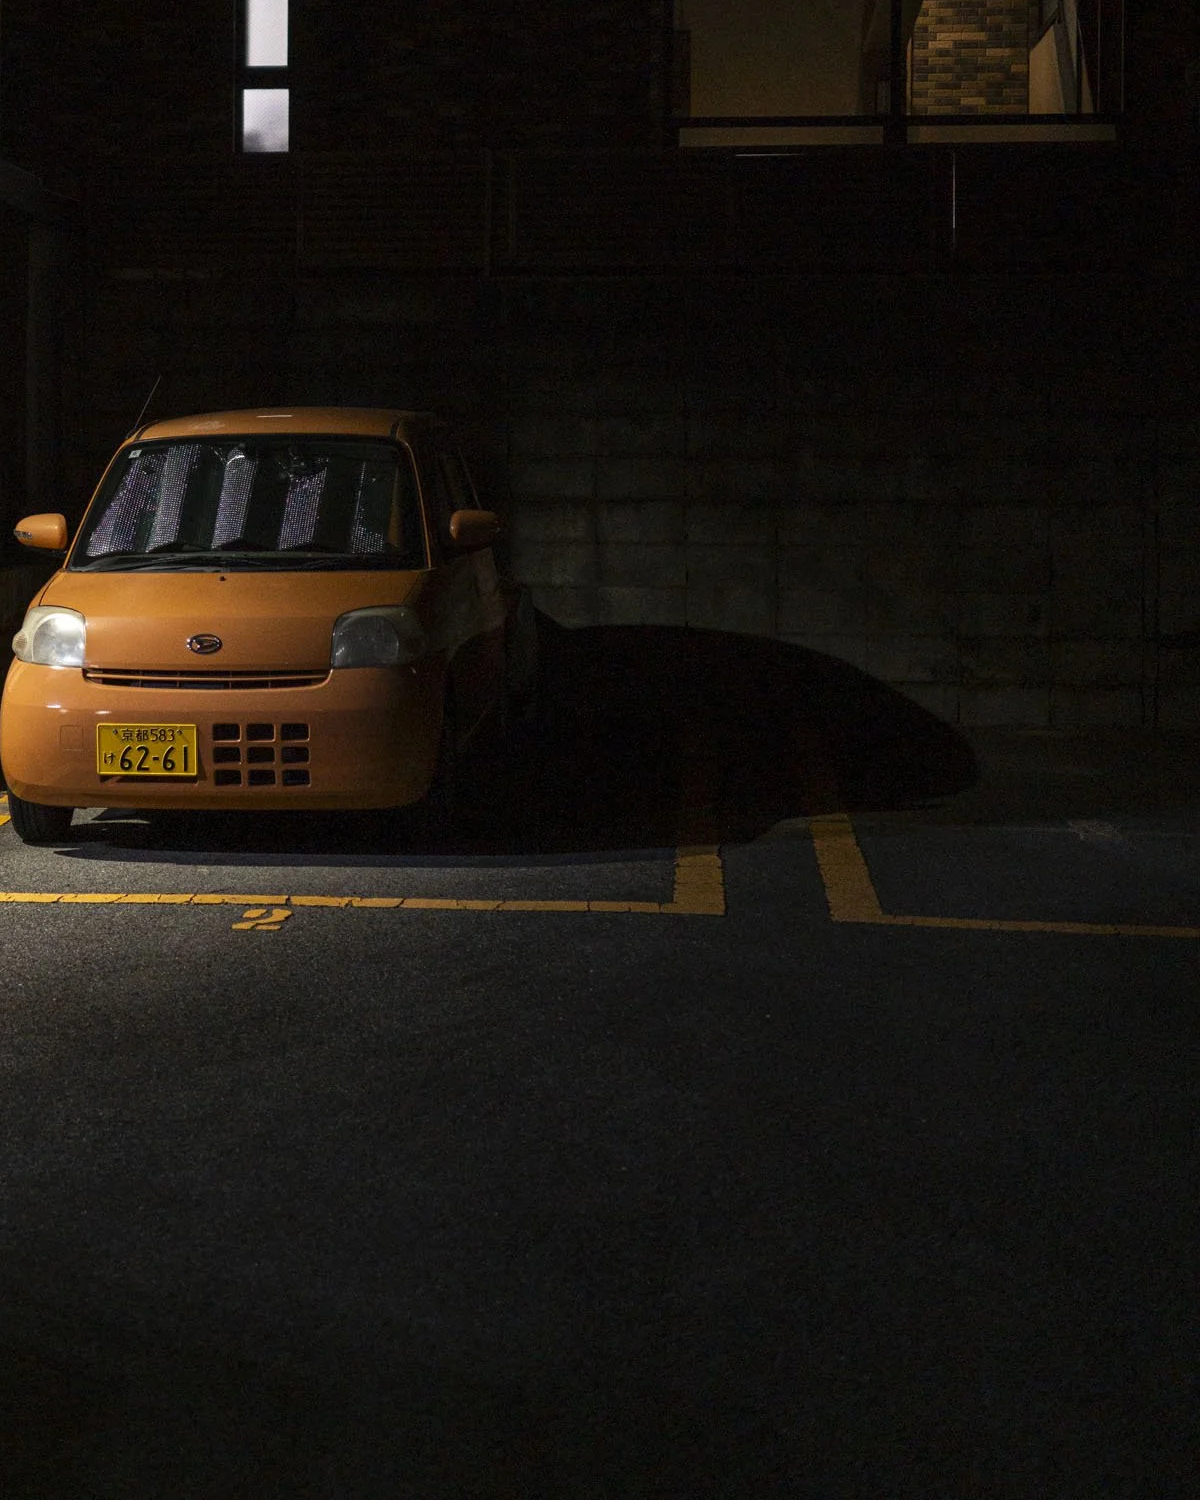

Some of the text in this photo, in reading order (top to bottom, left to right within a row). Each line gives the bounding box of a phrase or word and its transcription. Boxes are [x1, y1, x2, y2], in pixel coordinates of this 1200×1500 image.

[103, 745, 188, 772] け 62-61
[231, 908, 293, 930] 2
